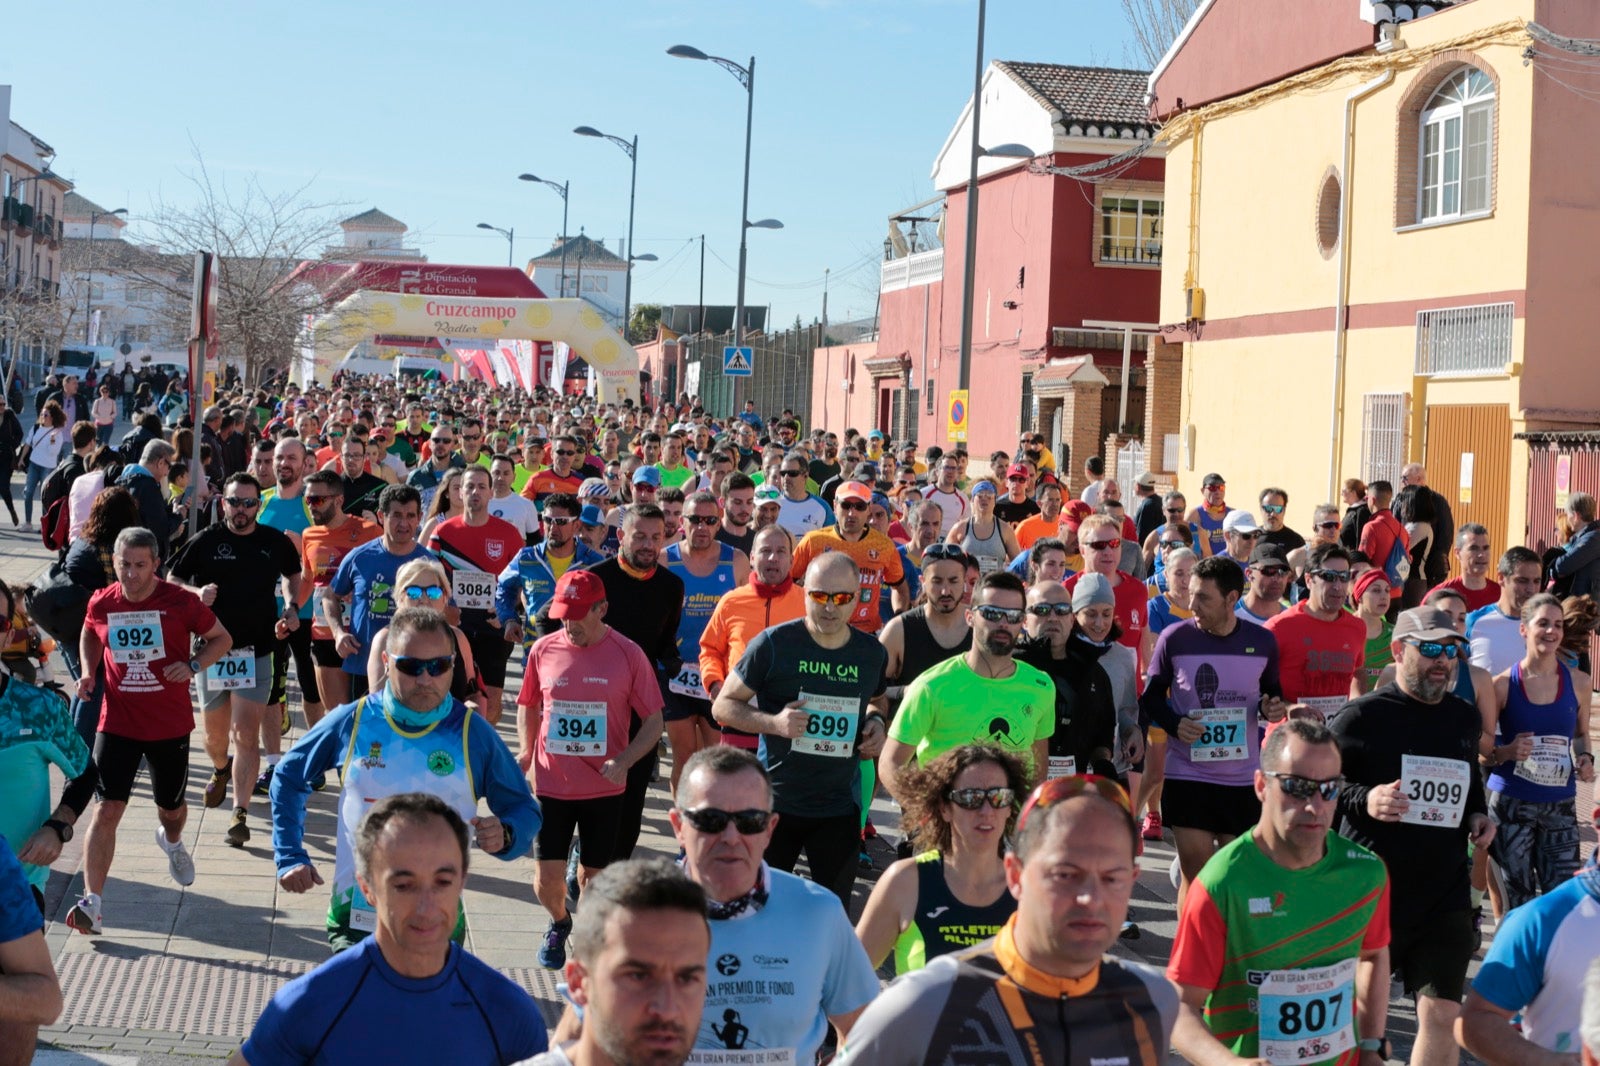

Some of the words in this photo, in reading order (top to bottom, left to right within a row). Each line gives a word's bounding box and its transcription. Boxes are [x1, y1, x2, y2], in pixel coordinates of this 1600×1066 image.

[424, 271, 477, 284] Diputación
[423, 284, 435, 294] de
[436, 284, 477, 296] Granada
[426, 301, 517, 320] Cruzcampo
[434, 321, 478, 334] Radler
[457, 582, 492, 597] 3084
[117, 627, 154, 647] 992
[216, 660, 248, 676] 704
[799, 659, 831, 676] RUN
[836, 664, 859, 678] ON
[678, 671, 702, 687] 43
[557, 717, 597, 738] 394
[806, 713, 849, 738] 699
[1200, 724, 1238, 744] 687
[1407, 779, 1462, 805] 3099
[718, 981, 753, 996] PREMIO
[755, 981, 766, 995] DE
[769, 981, 795, 996] FONDO
[1278, 991, 1343, 1035] 807
[703, 1053, 723, 1064] GRAN
[725, 1052, 754, 1064] PREMIO
[756, 1052, 765, 1062] DE
[767, 1050, 789, 1061] FONDO
